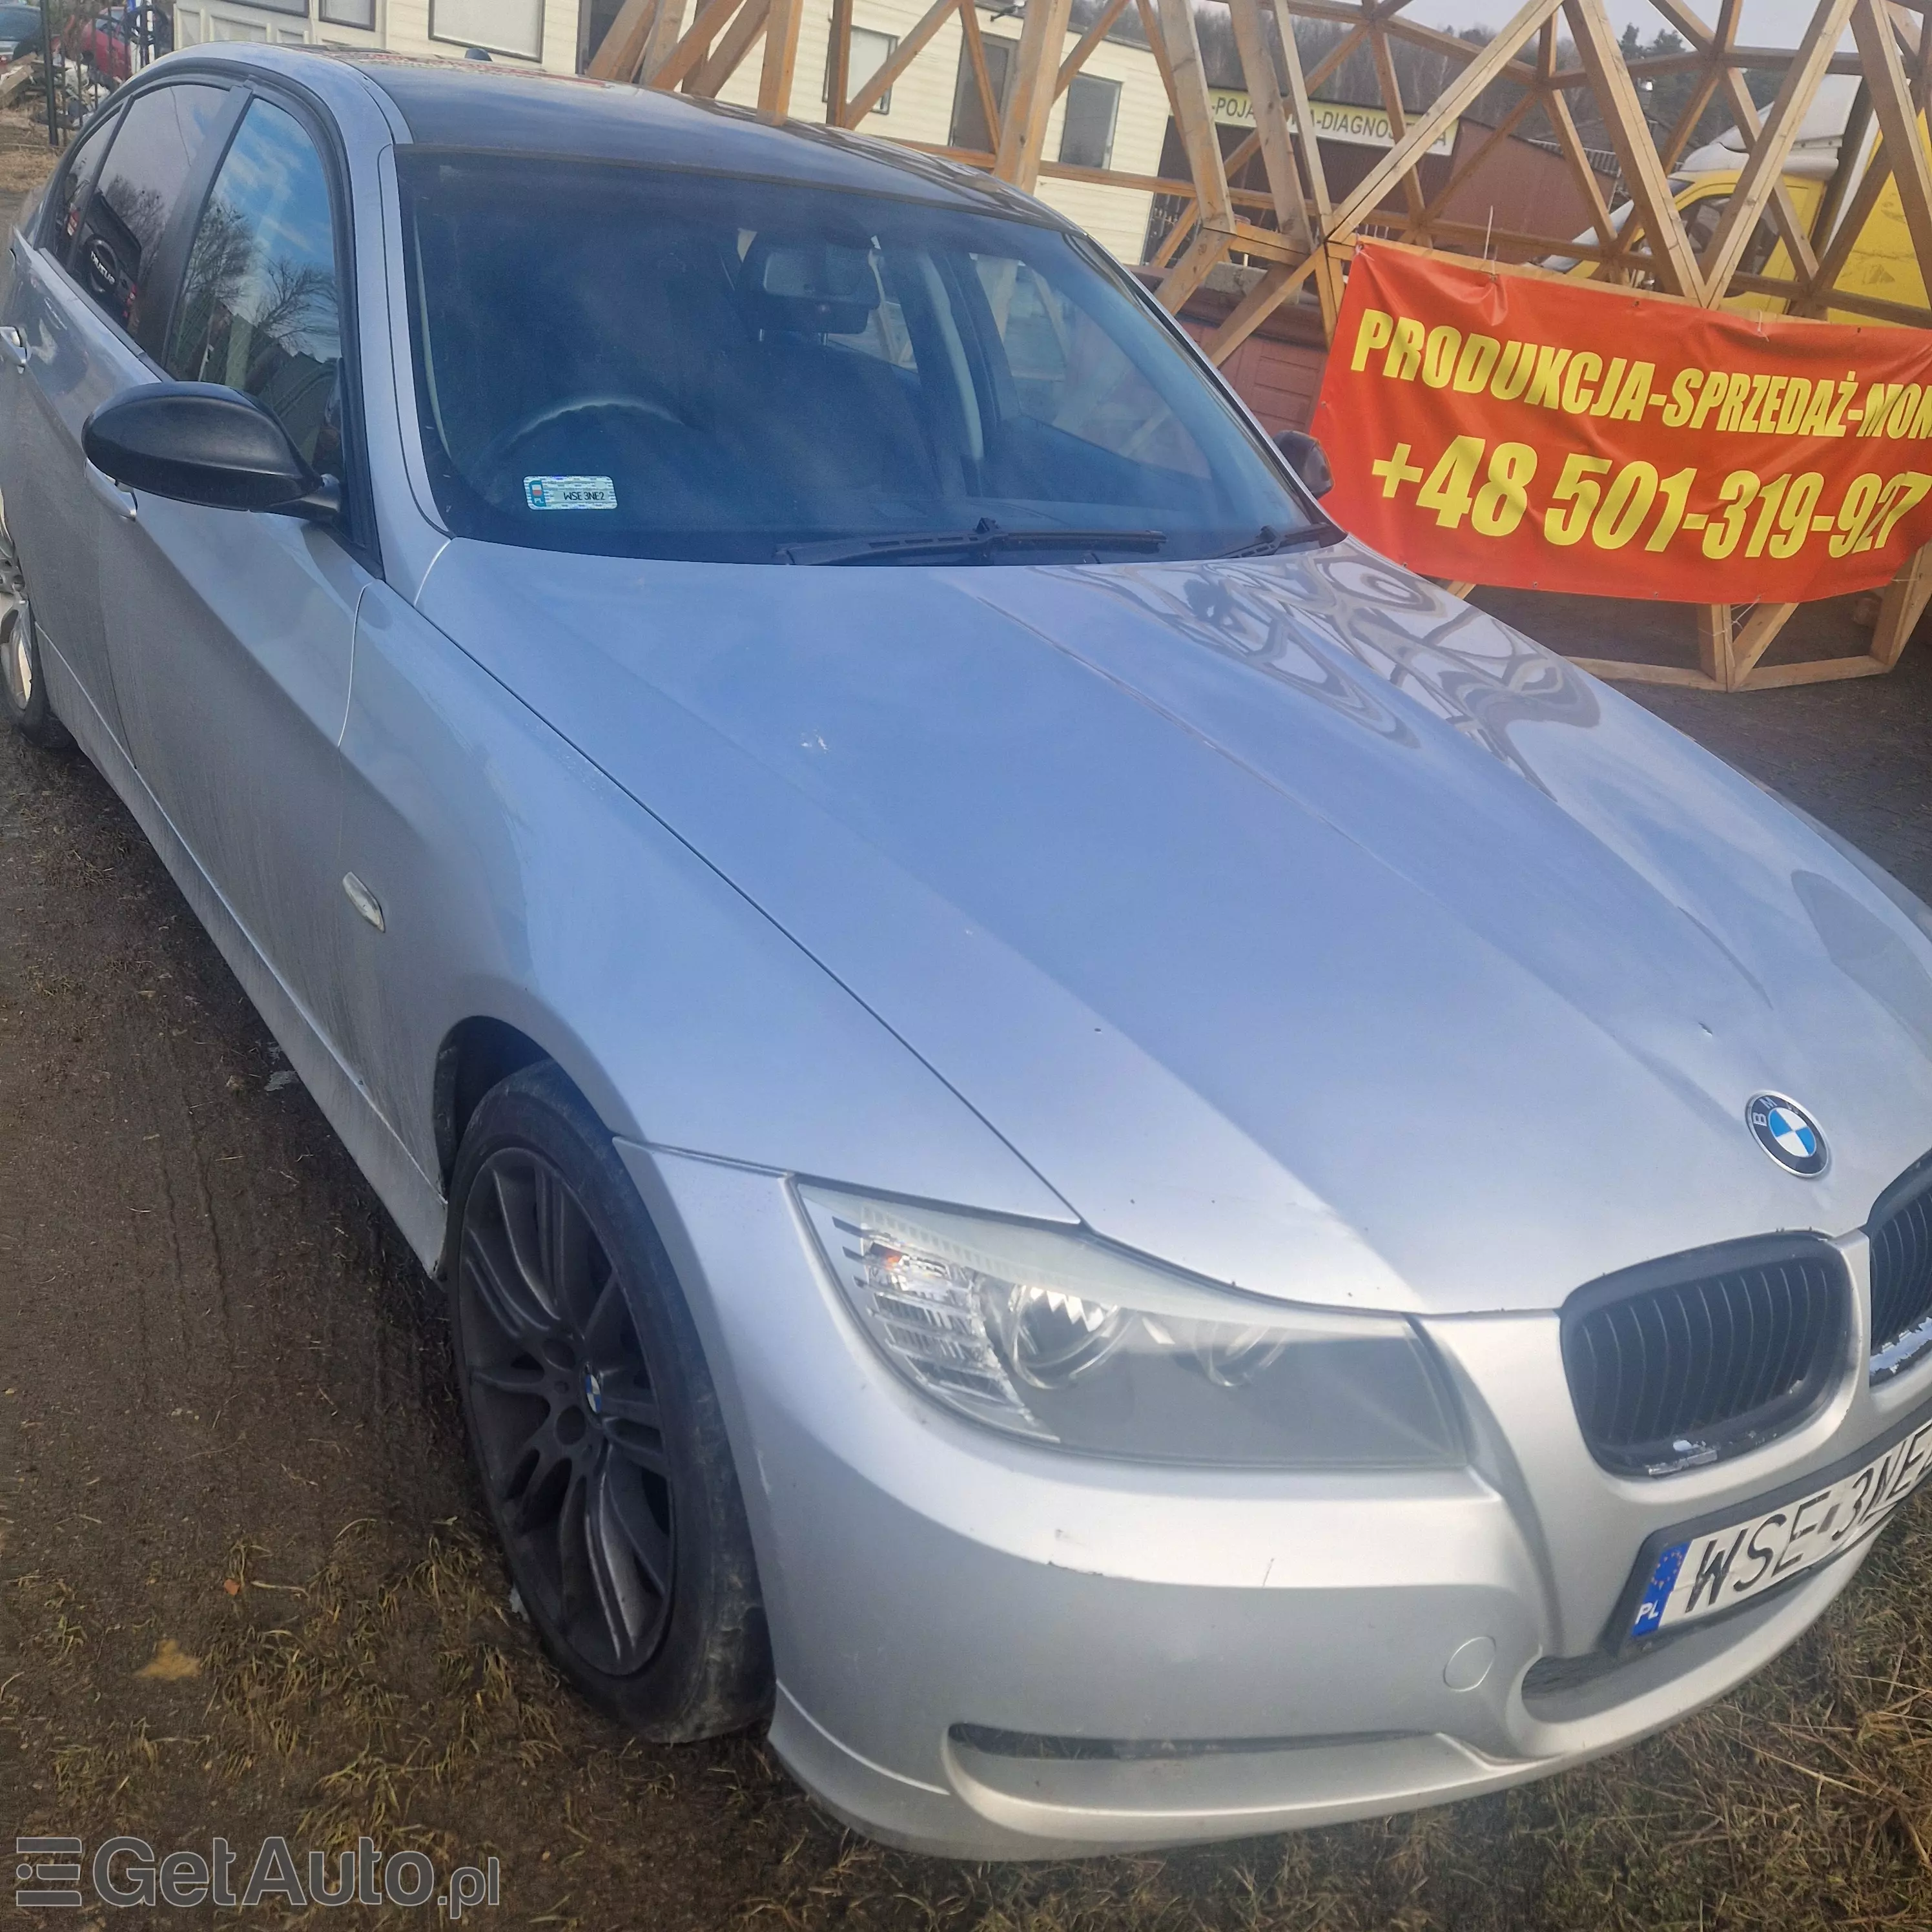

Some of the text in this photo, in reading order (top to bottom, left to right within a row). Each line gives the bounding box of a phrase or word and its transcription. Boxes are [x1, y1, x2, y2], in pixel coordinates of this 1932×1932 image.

[564, 491, 605, 500] WSE 3NE2
[1371, 435, 1932, 560] +48 501-319-927
[1685, 1490, 1831, 1614] WSE
[1635, 1602, 1659, 1624] PL
